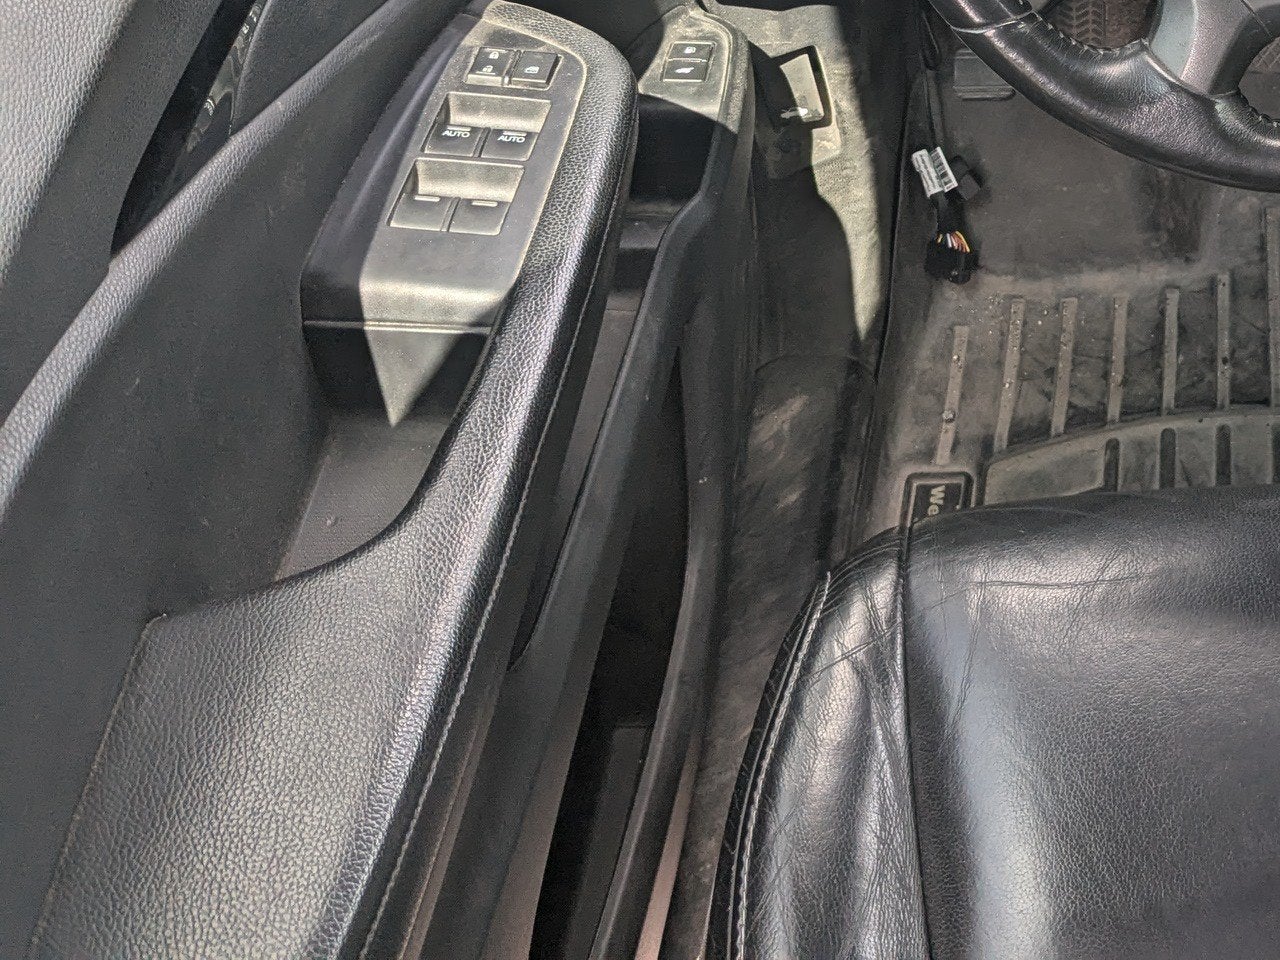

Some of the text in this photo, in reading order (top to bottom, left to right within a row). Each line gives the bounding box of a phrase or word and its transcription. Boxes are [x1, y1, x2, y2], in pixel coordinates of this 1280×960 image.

[442, 130, 470, 138] AUTO
[497, 135, 526, 143] AUTO
[928, 485, 945, 515] We
